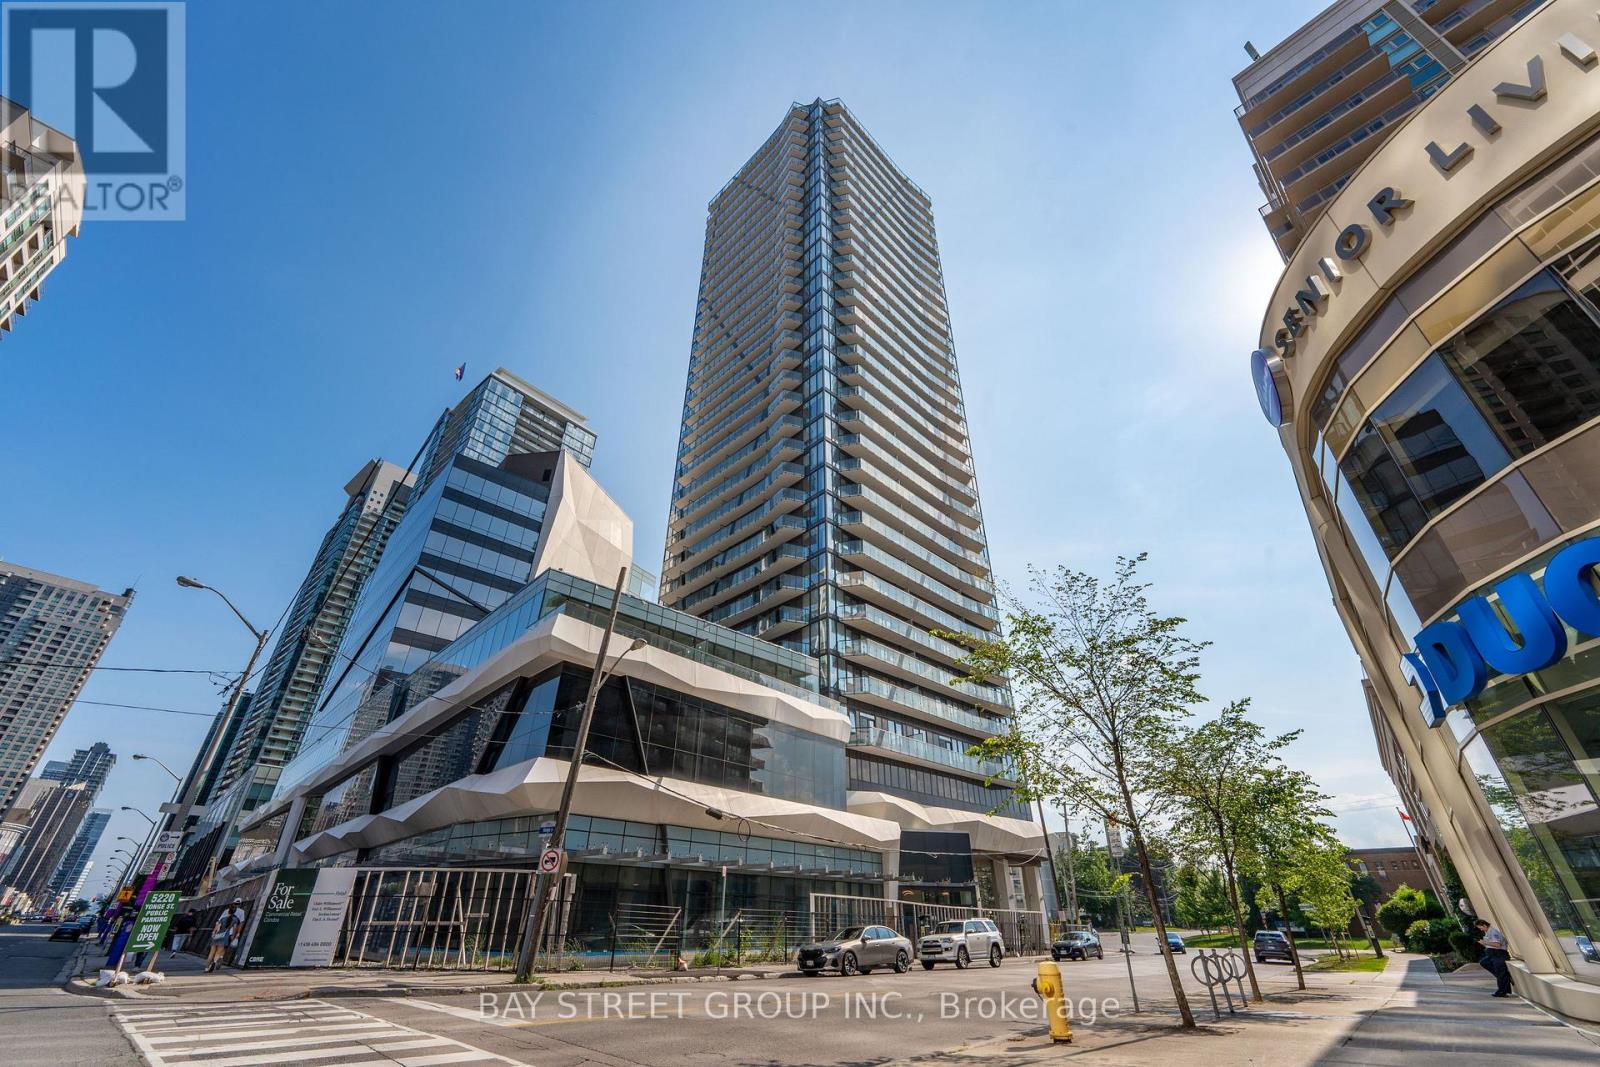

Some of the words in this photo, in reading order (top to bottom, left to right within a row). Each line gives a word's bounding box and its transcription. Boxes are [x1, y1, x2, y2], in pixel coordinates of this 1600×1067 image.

[1274, 186, 1415, 359] SENIOR
[1424, 9, 1600, 172] LIVI
[274, 882, 295, 896] For
[151, 893, 176, 903] 5220
[268, 895, 295, 910] Sale
[141, 924, 161, 933] NOW
[136, 932, 159, 941] OPEN
